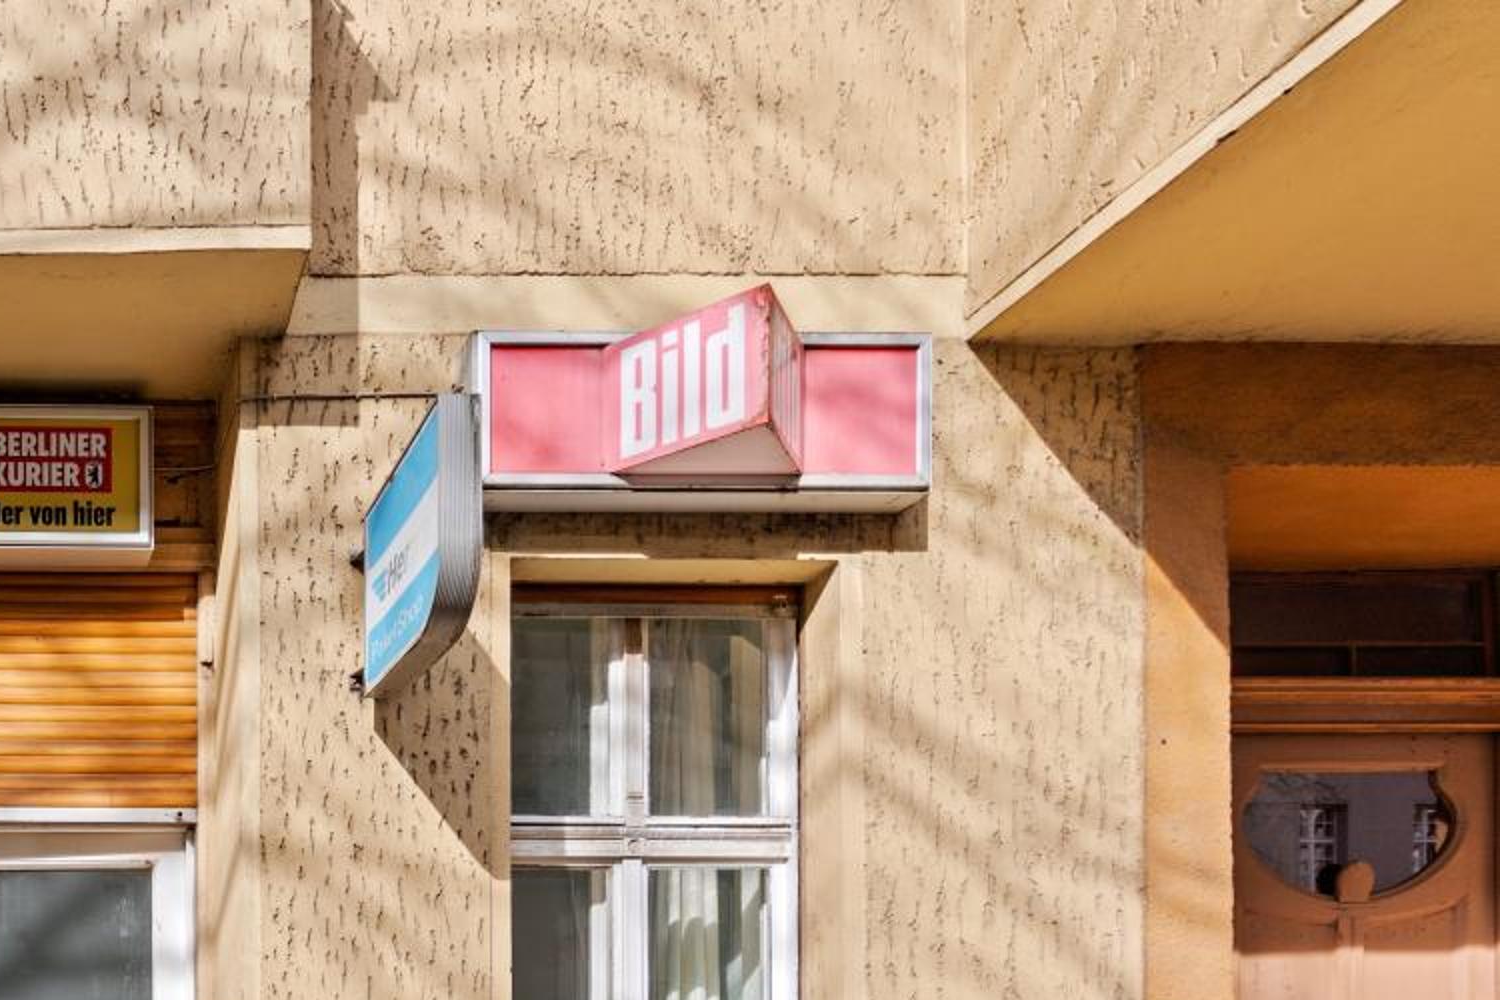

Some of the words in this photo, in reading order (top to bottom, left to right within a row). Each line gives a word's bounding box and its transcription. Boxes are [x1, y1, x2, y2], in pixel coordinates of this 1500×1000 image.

[619, 303, 746, 460] Bild
[29, 505, 67, 526] von
[73, 501, 116, 526] hier
